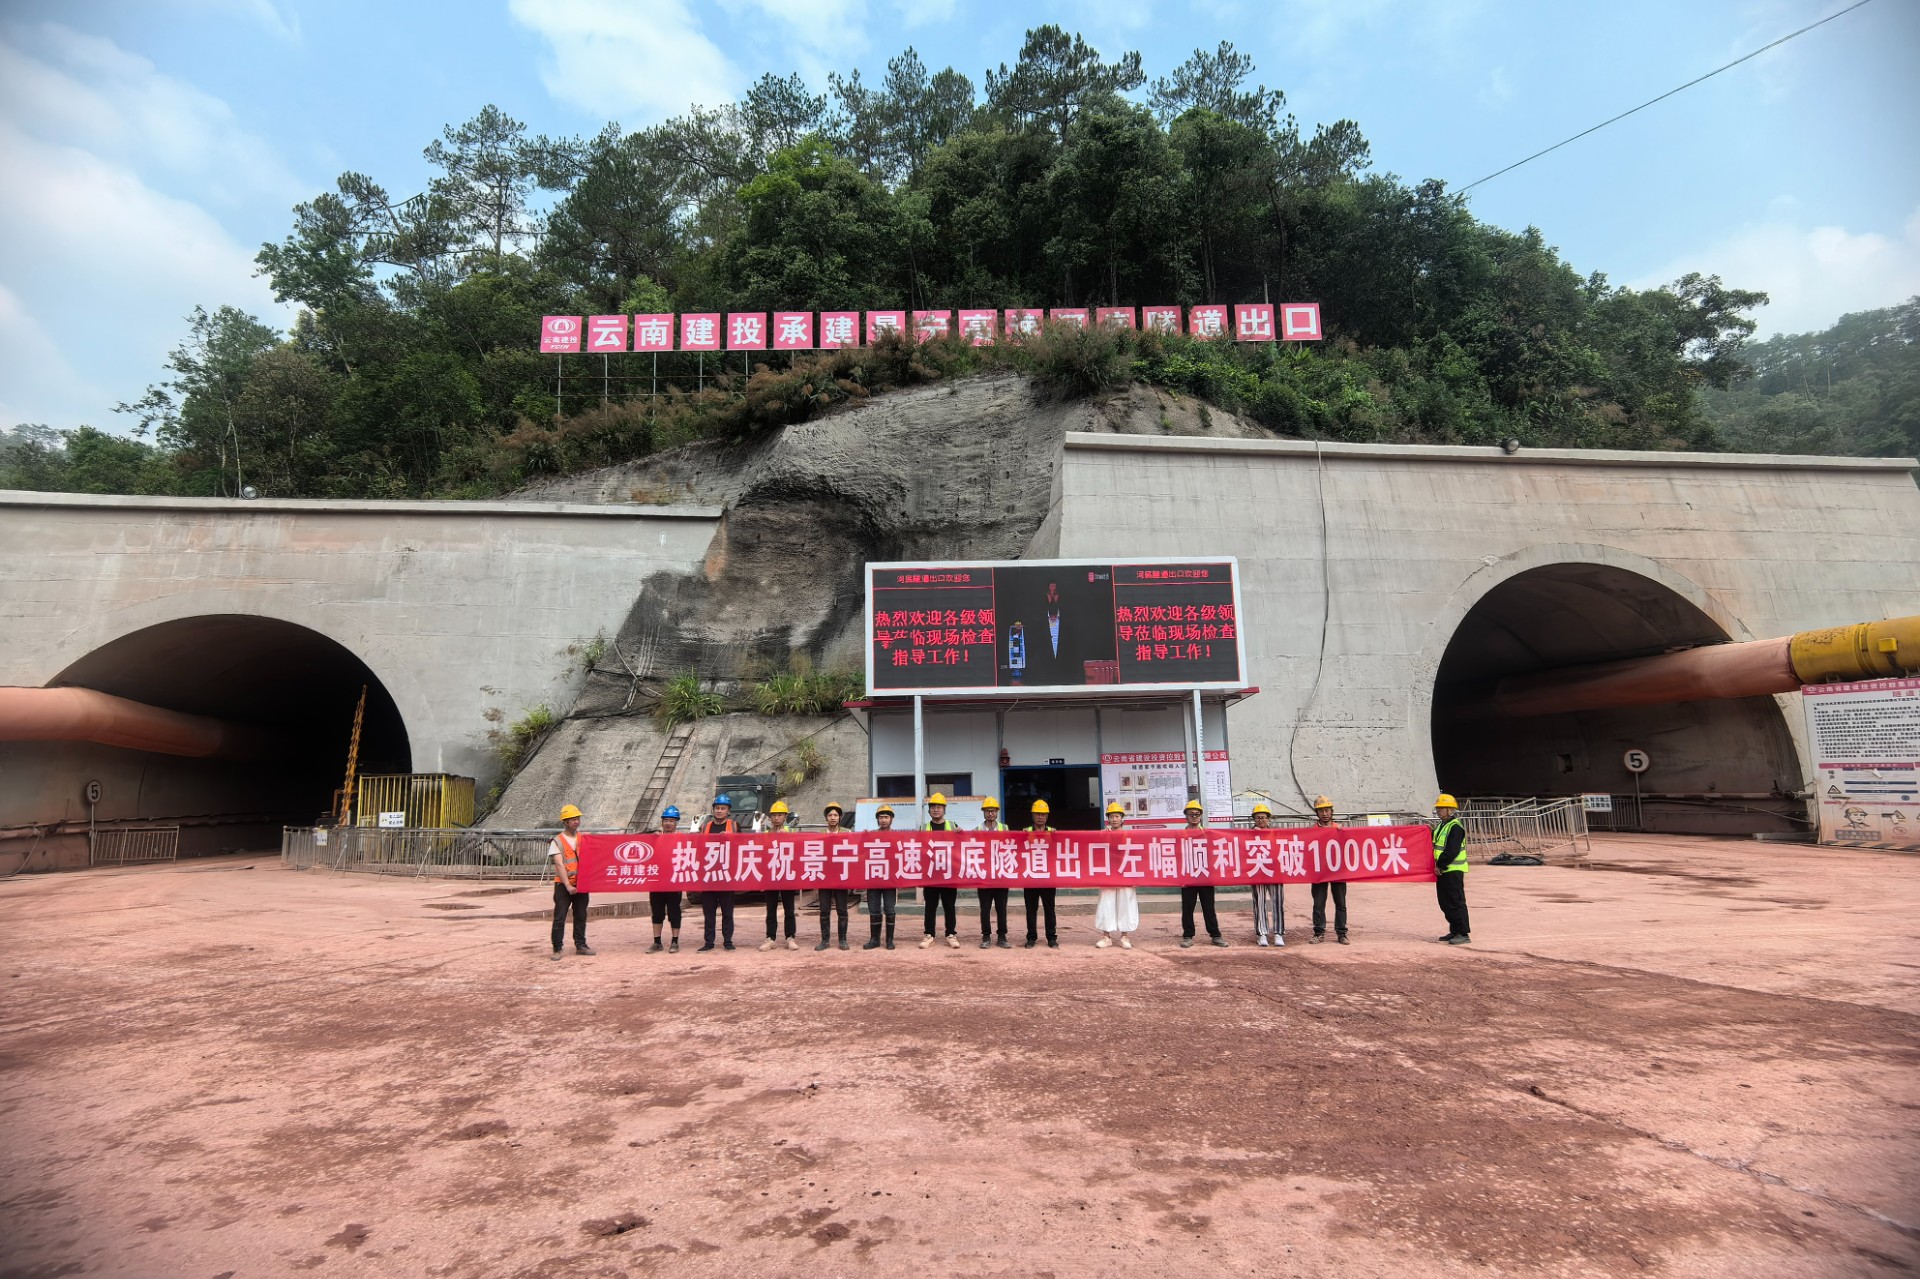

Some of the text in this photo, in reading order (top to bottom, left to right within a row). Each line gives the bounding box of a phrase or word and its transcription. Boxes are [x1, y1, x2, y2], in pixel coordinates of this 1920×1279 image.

[874, 608, 995, 628] 热烈欢迎各级领
[1117, 604, 1236, 623] 热烈欢迎各级领
[1117, 623, 1237, 642] 导莅临现场检查
[1113, 752, 1226, 763] 云南省建设投资控股限公司
[1629, 752, 1643, 768] 5
[91, 784, 99, 800] 5
[670, 834, 1410, 884] 热烈庆祝景宁高速河底隧道出口左幅顺利突破1000米
[605, 864, 660, 876] 云南建投
[616, 877, 648, 885] YCIH
